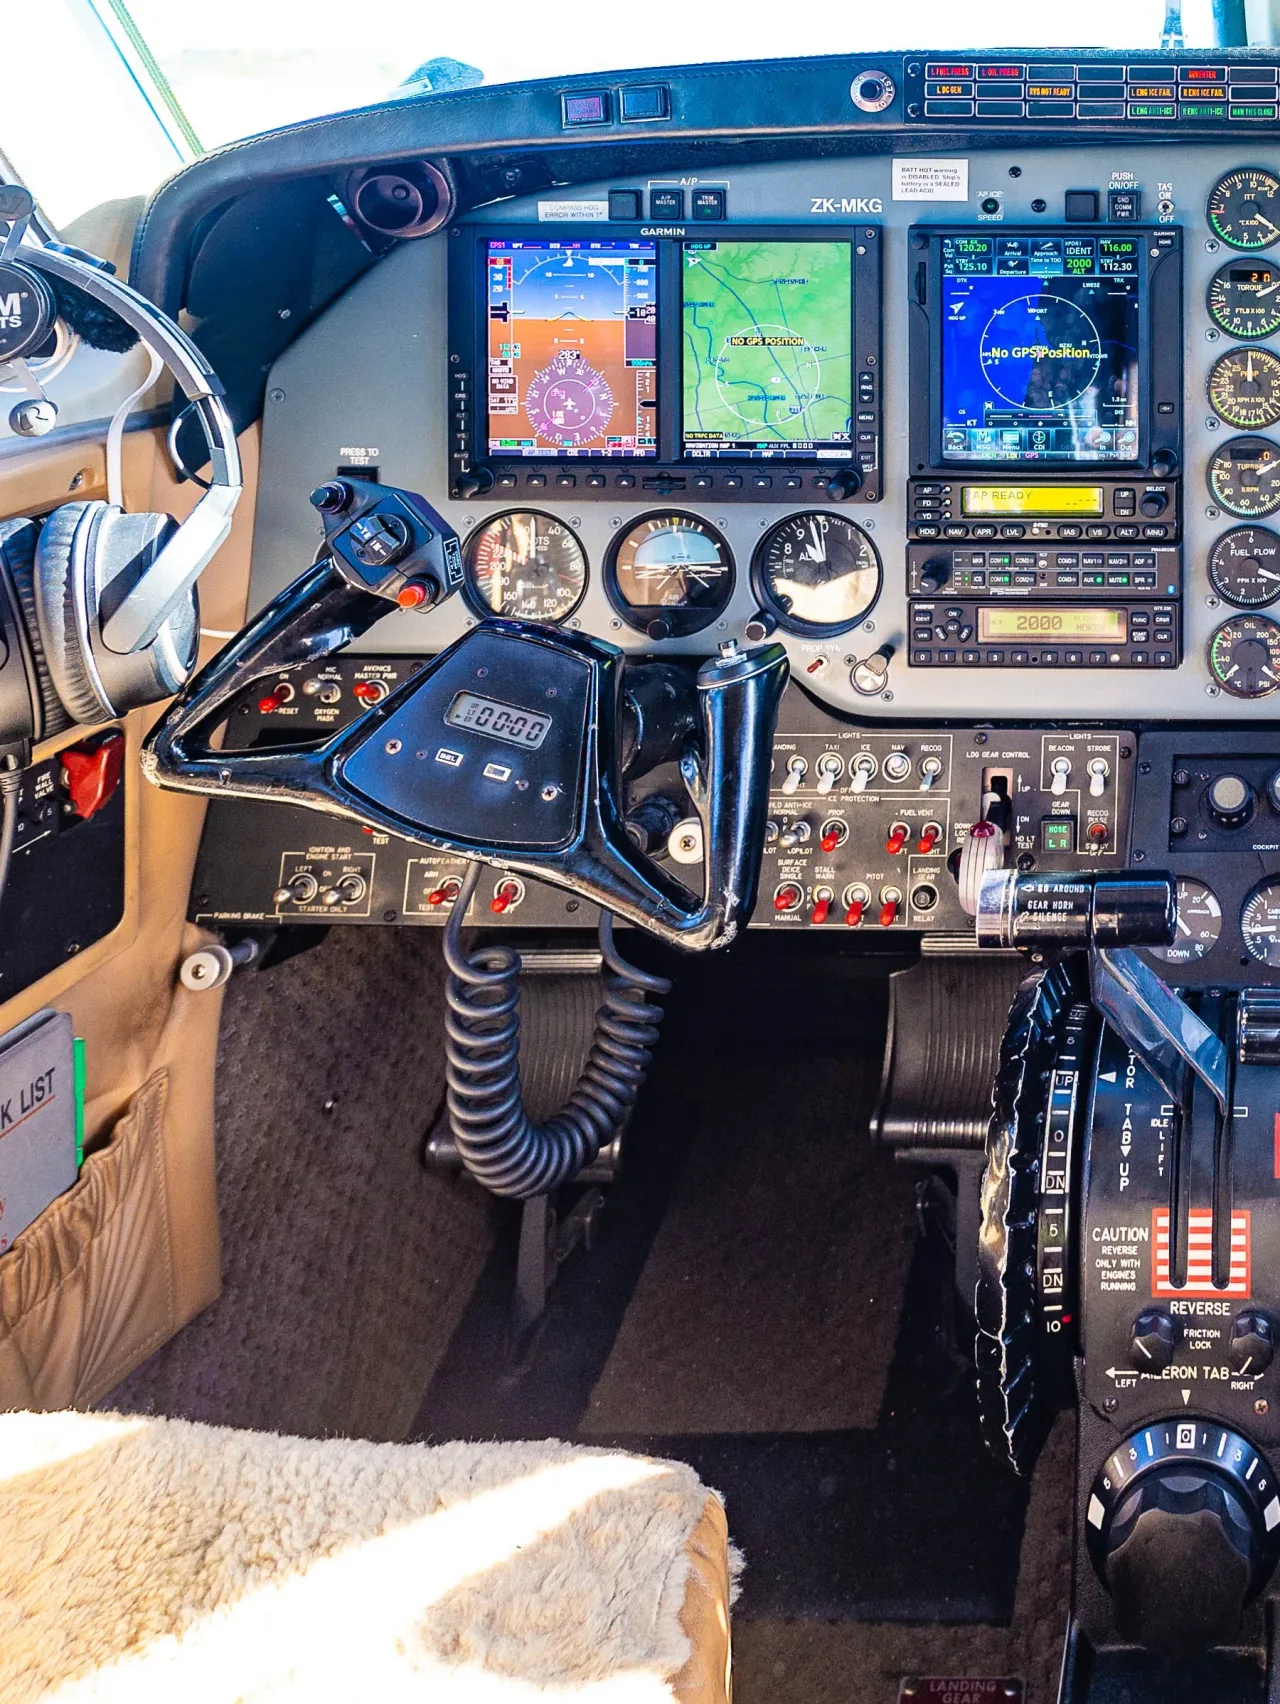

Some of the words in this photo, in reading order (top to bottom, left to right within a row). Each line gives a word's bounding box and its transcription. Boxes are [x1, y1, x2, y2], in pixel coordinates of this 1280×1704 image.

[1112, 172, 1133, 181] PUSH
[680, 177, 698, 186] A/P
[1108, 181, 1139, 190] ON/OFF
[1157, 183, 1172, 191] TAS
[810, 198, 883, 213] ZK-MKG
[1159, 215, 1174, 223] OFF
[641, 228, 685, 236] GARMIN
[959, 243, 987, 252] 120.20
[1066, 247, 1092, 256] IDENT
[1103, 243, 1132, 252] 116.00
[959, 262, 987, 271] 125.10
[1067, 258, 1092, 268] 2000
[1103, 262, 1132, 271] 112.30
[731, 337, 745, 345] NO
[746, 337, 763, 345] GPS
[766, 337, 804, 346] POSITION
[991, 347, 1009, 358] No
[1012, 347, 1036, 358] GPS
[1041, 347, 1090, 358] Position
[340, 448, 365, 456] PRESS
[366, 448, 379, 456] TO
[350, 457, 369, 465] TEST
[973, 491, 988, 500] AP
[992, 491, 1032, 500] READY
[1230, 548, 1250, 556] FUEL
[1254, 548, 1276, 556] FLOW
[1017, 616, 1063, 630] 2000
[479, 707, 545, 742] 00:00
[1053, 885, 1084, 893] AROUND
[1028, 901, 1048, 909] GEAR
[1053, 901, 1074, 909] HORN
[1033, 913, 1067, 922] SILENCE
[20, 1067, 55, 1115] LIST
[1092, 1227, 1148, 1242] CAUTION
[1102, 1246, 1138, 1255] REVERSE
[1095, 1259, 1118, 1268] ONLY
[1121, 1259, 1140, 1268] WITH
[1101, 1270, 1136, 1280] ENGINES
[1101, 1282, 1136, 1291] RUNNING
[1170, 1302, 1231, 1315] REVERSE
[1184, 1329, 1220, 1338] FRICTION
[1190, 1341, 1211, 1349] LOCK
[1203, 1366, 1229, 1380] TAB
[1115, 1379, 1136, 1388] LEFT
[1231, 1381, 1255, 1390] RIGHT
